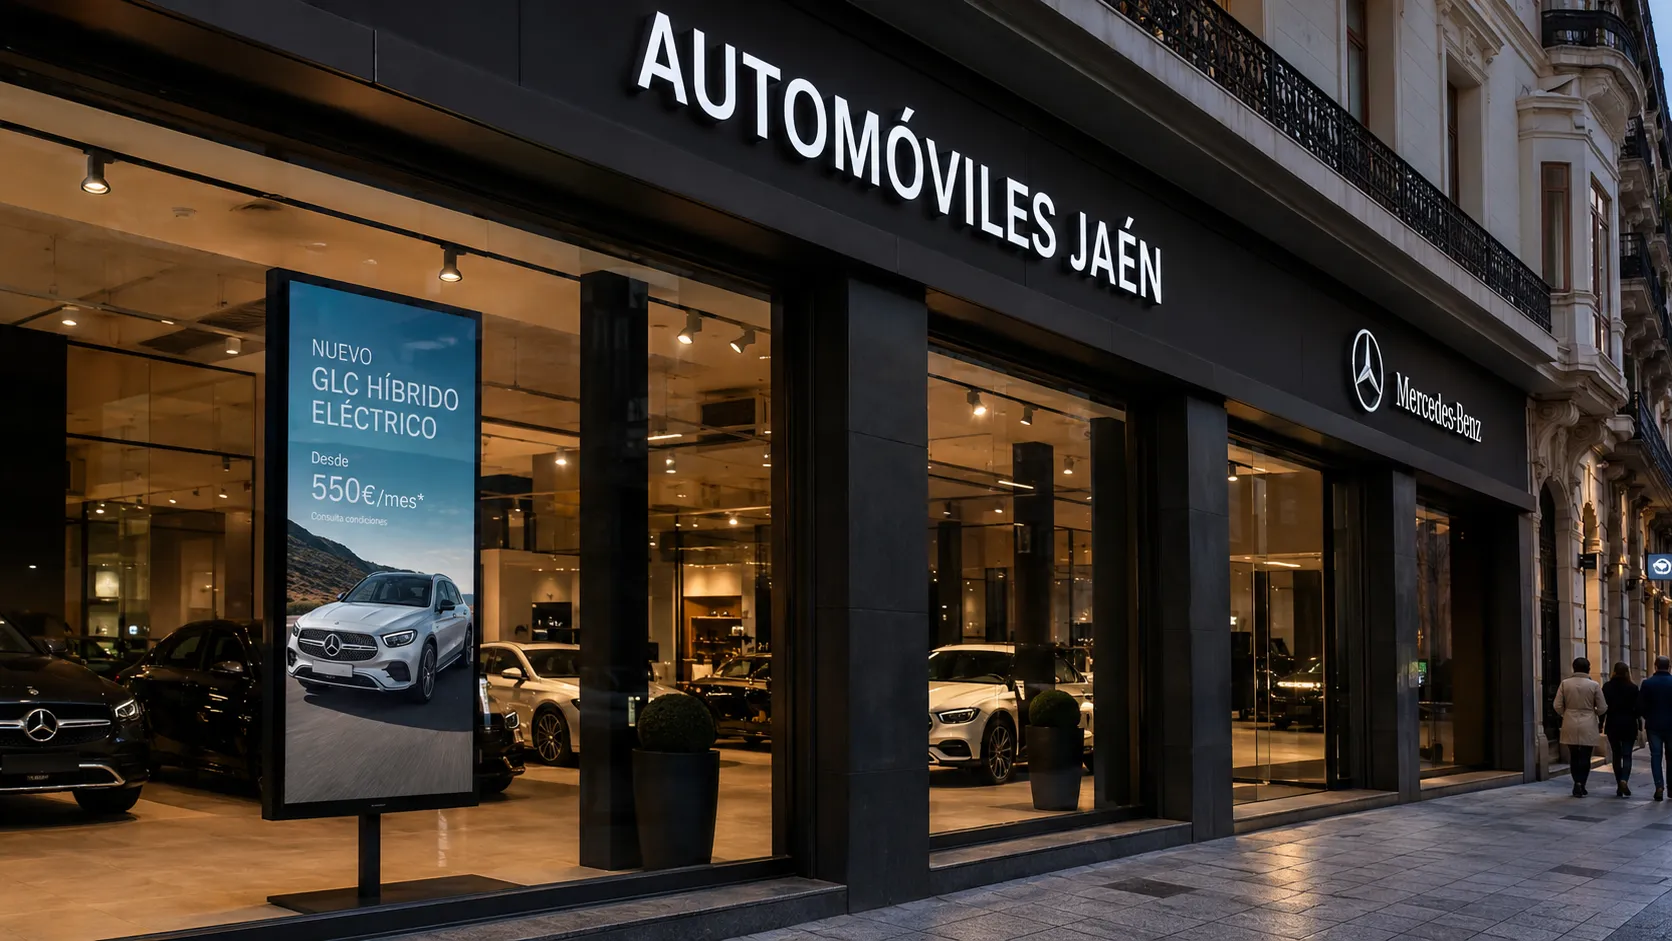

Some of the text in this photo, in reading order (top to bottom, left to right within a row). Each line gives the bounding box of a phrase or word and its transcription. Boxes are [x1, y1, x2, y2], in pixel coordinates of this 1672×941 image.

[637, 11, 1163, 306] AUTOMÓVILES JAÉN
[312, 338, 372, 365] NUEVO
[311, 366, 459, 411] GLC HÍBRIDO
[1395, 371, 1483, 443] Mercedes-Benz
[312, 399, 437, 440] ELÉCTRICO
[311, 450, 349, 468] Desde
[311, 511, 344, 523] Consulta
